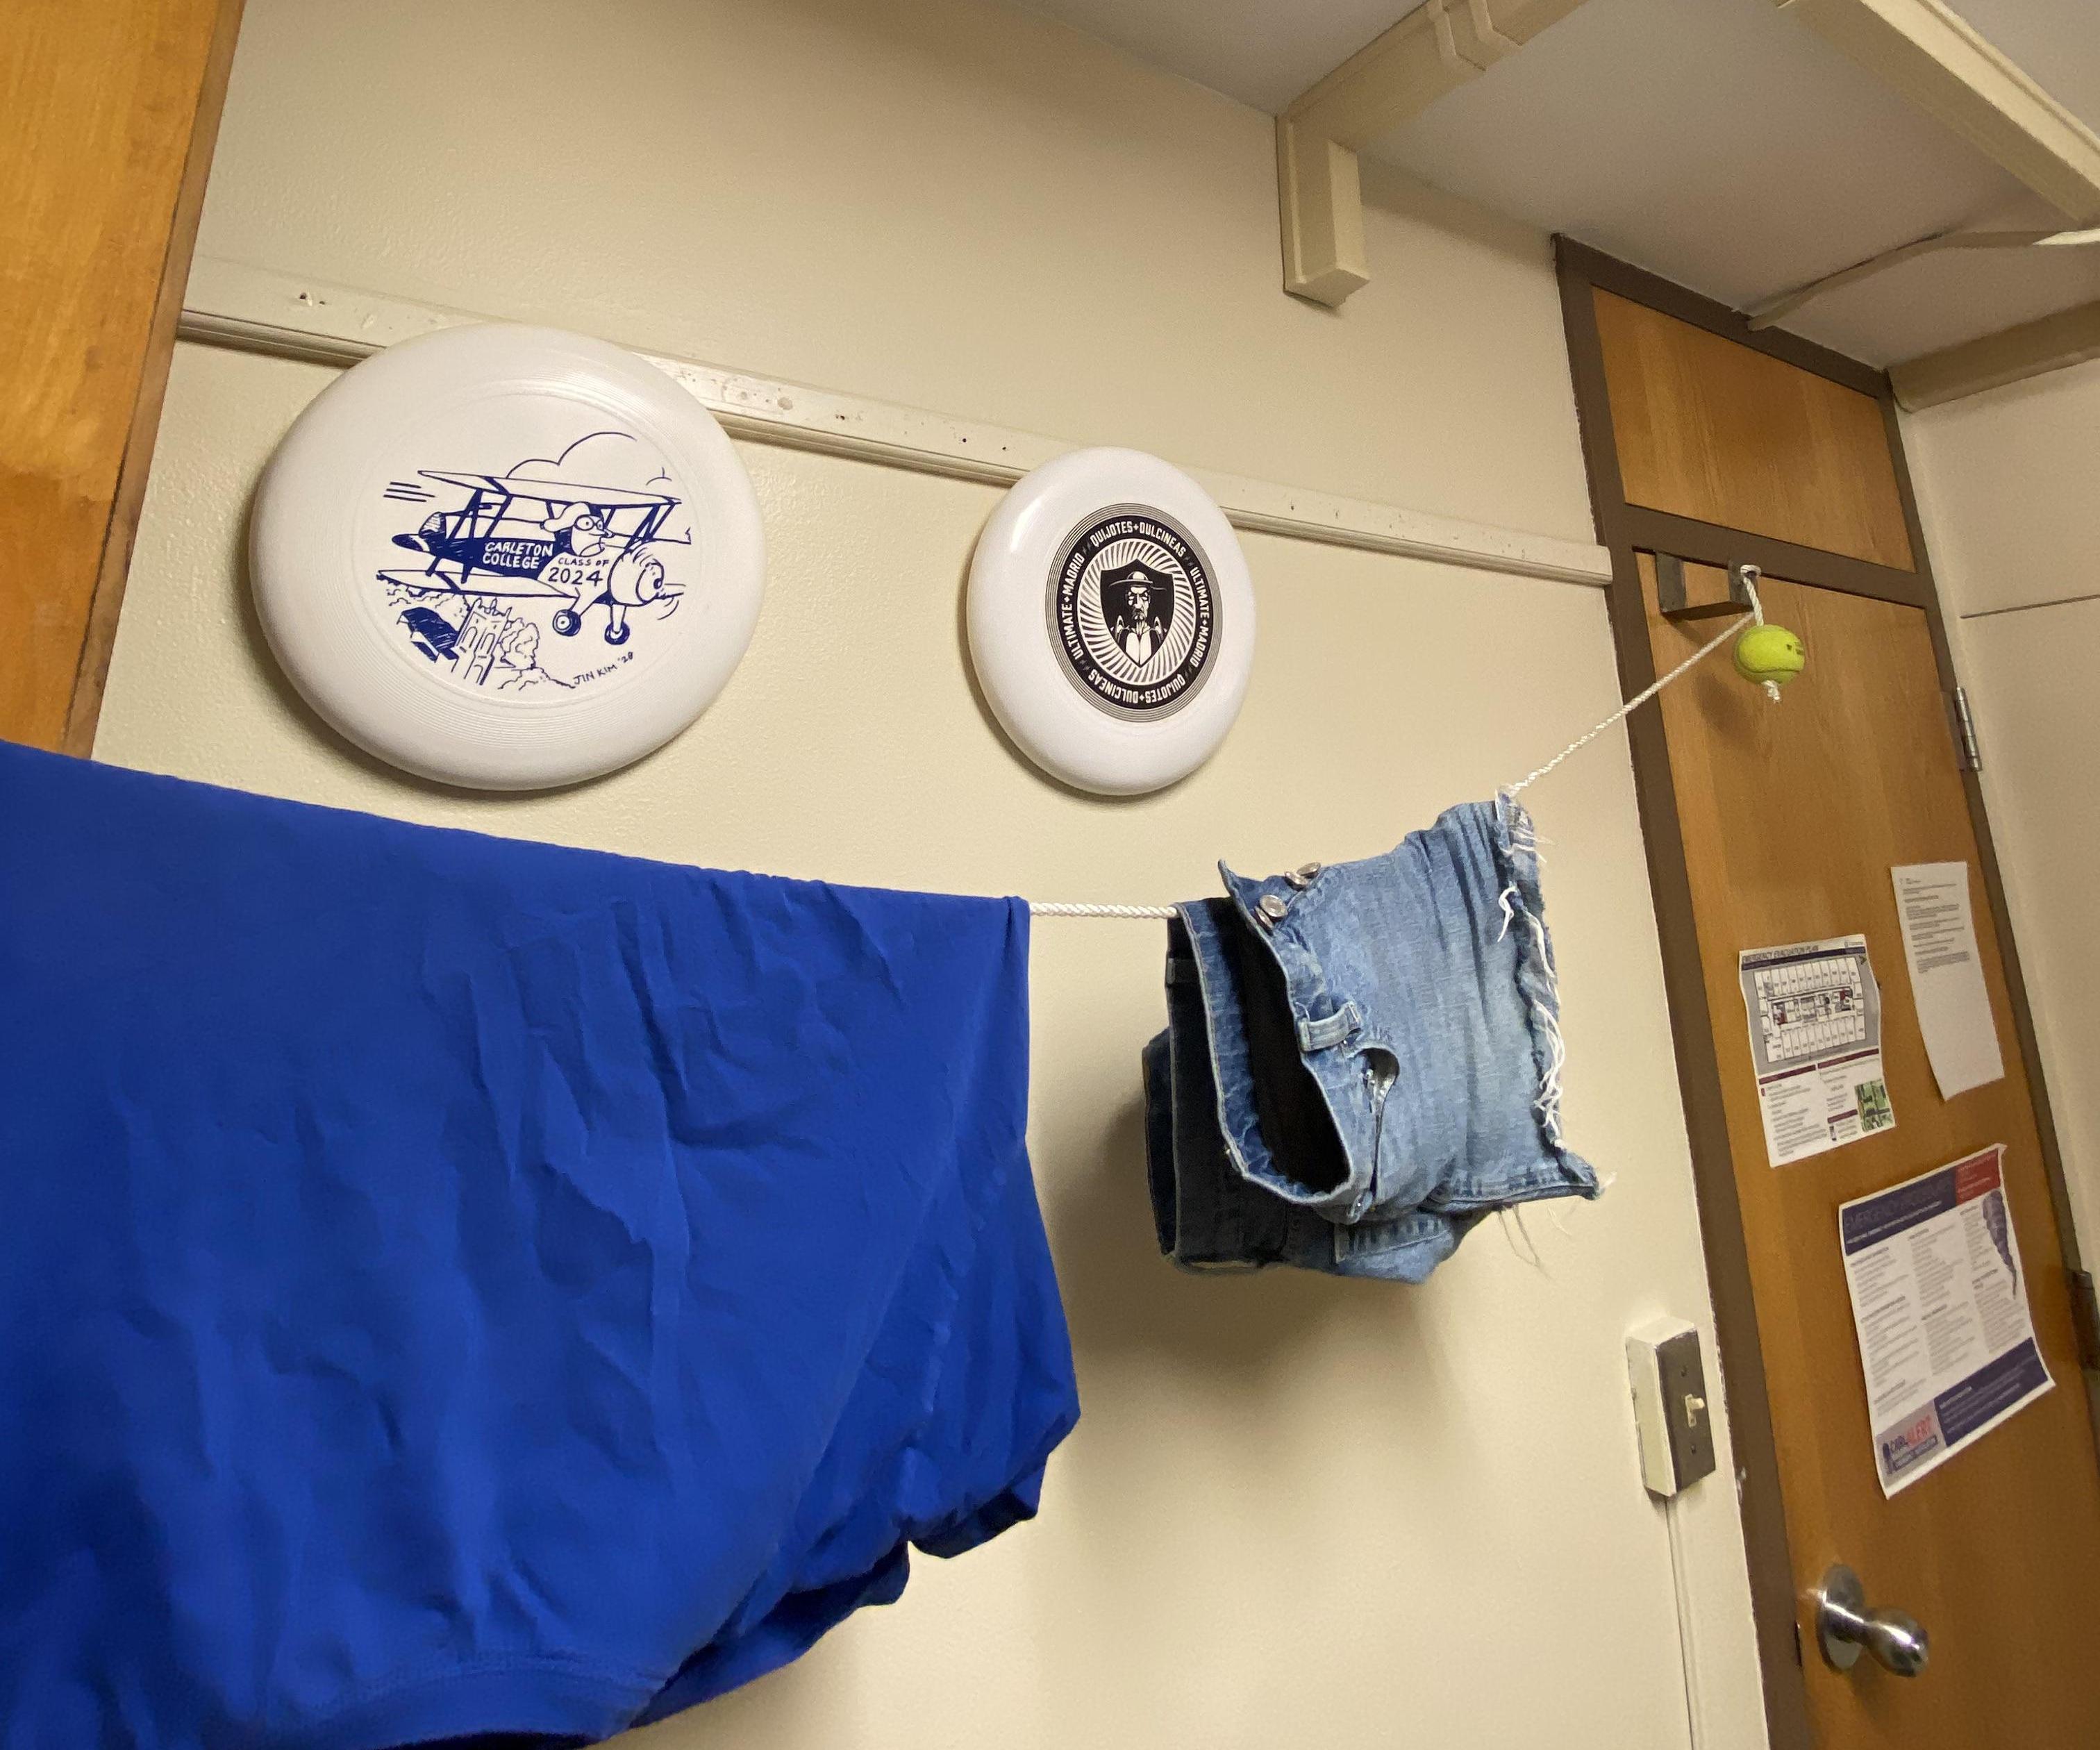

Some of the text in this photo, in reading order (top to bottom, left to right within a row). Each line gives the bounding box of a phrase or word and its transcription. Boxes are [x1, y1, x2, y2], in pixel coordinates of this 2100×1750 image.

[484, 541, 554, 557] CARLETON
[1090, 521, 1187, 557] QUIJOTES DULCINEAS
[482, 553, 540, 569] COLLEGE
[548, 567, 603, 587] 2024
[558, 557, 592, 566] CLASS
[1062, 552, 1085, 597] MADRID
[1189, 567, 1210, 618] ULTIMATE
[1060, 603, 1084, 660] ULTIMATE
[1192, 626, 1209, 667] MADRID
[573, 671, 595, 685] JIN
[597, 664, 617, 677] KIM
[1088, 668, 1186, 703] DULCINEAS QUIJOTES
